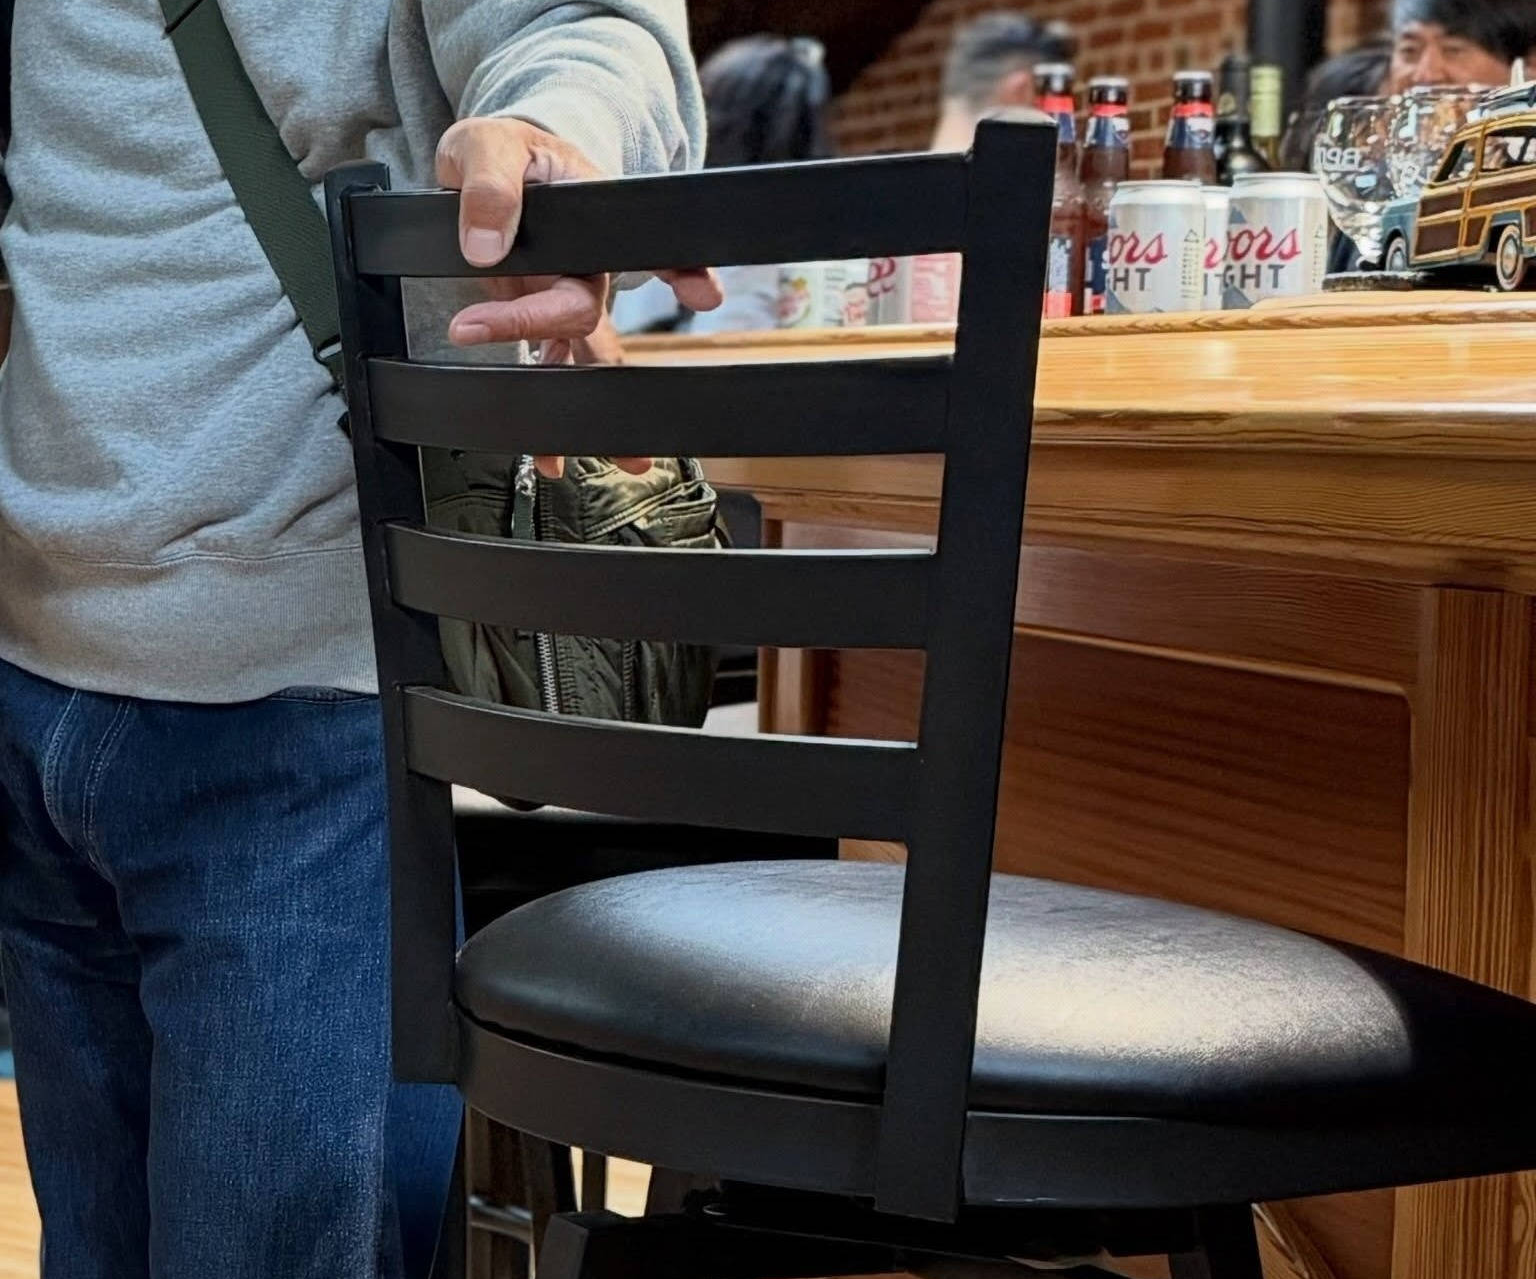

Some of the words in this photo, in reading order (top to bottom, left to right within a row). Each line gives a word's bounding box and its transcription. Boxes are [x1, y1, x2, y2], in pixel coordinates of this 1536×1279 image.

[1109, 231, 1168, 265] ors
[1225, 226, 1302, 261] ors
[1112, 268, 1152, 291] HT
